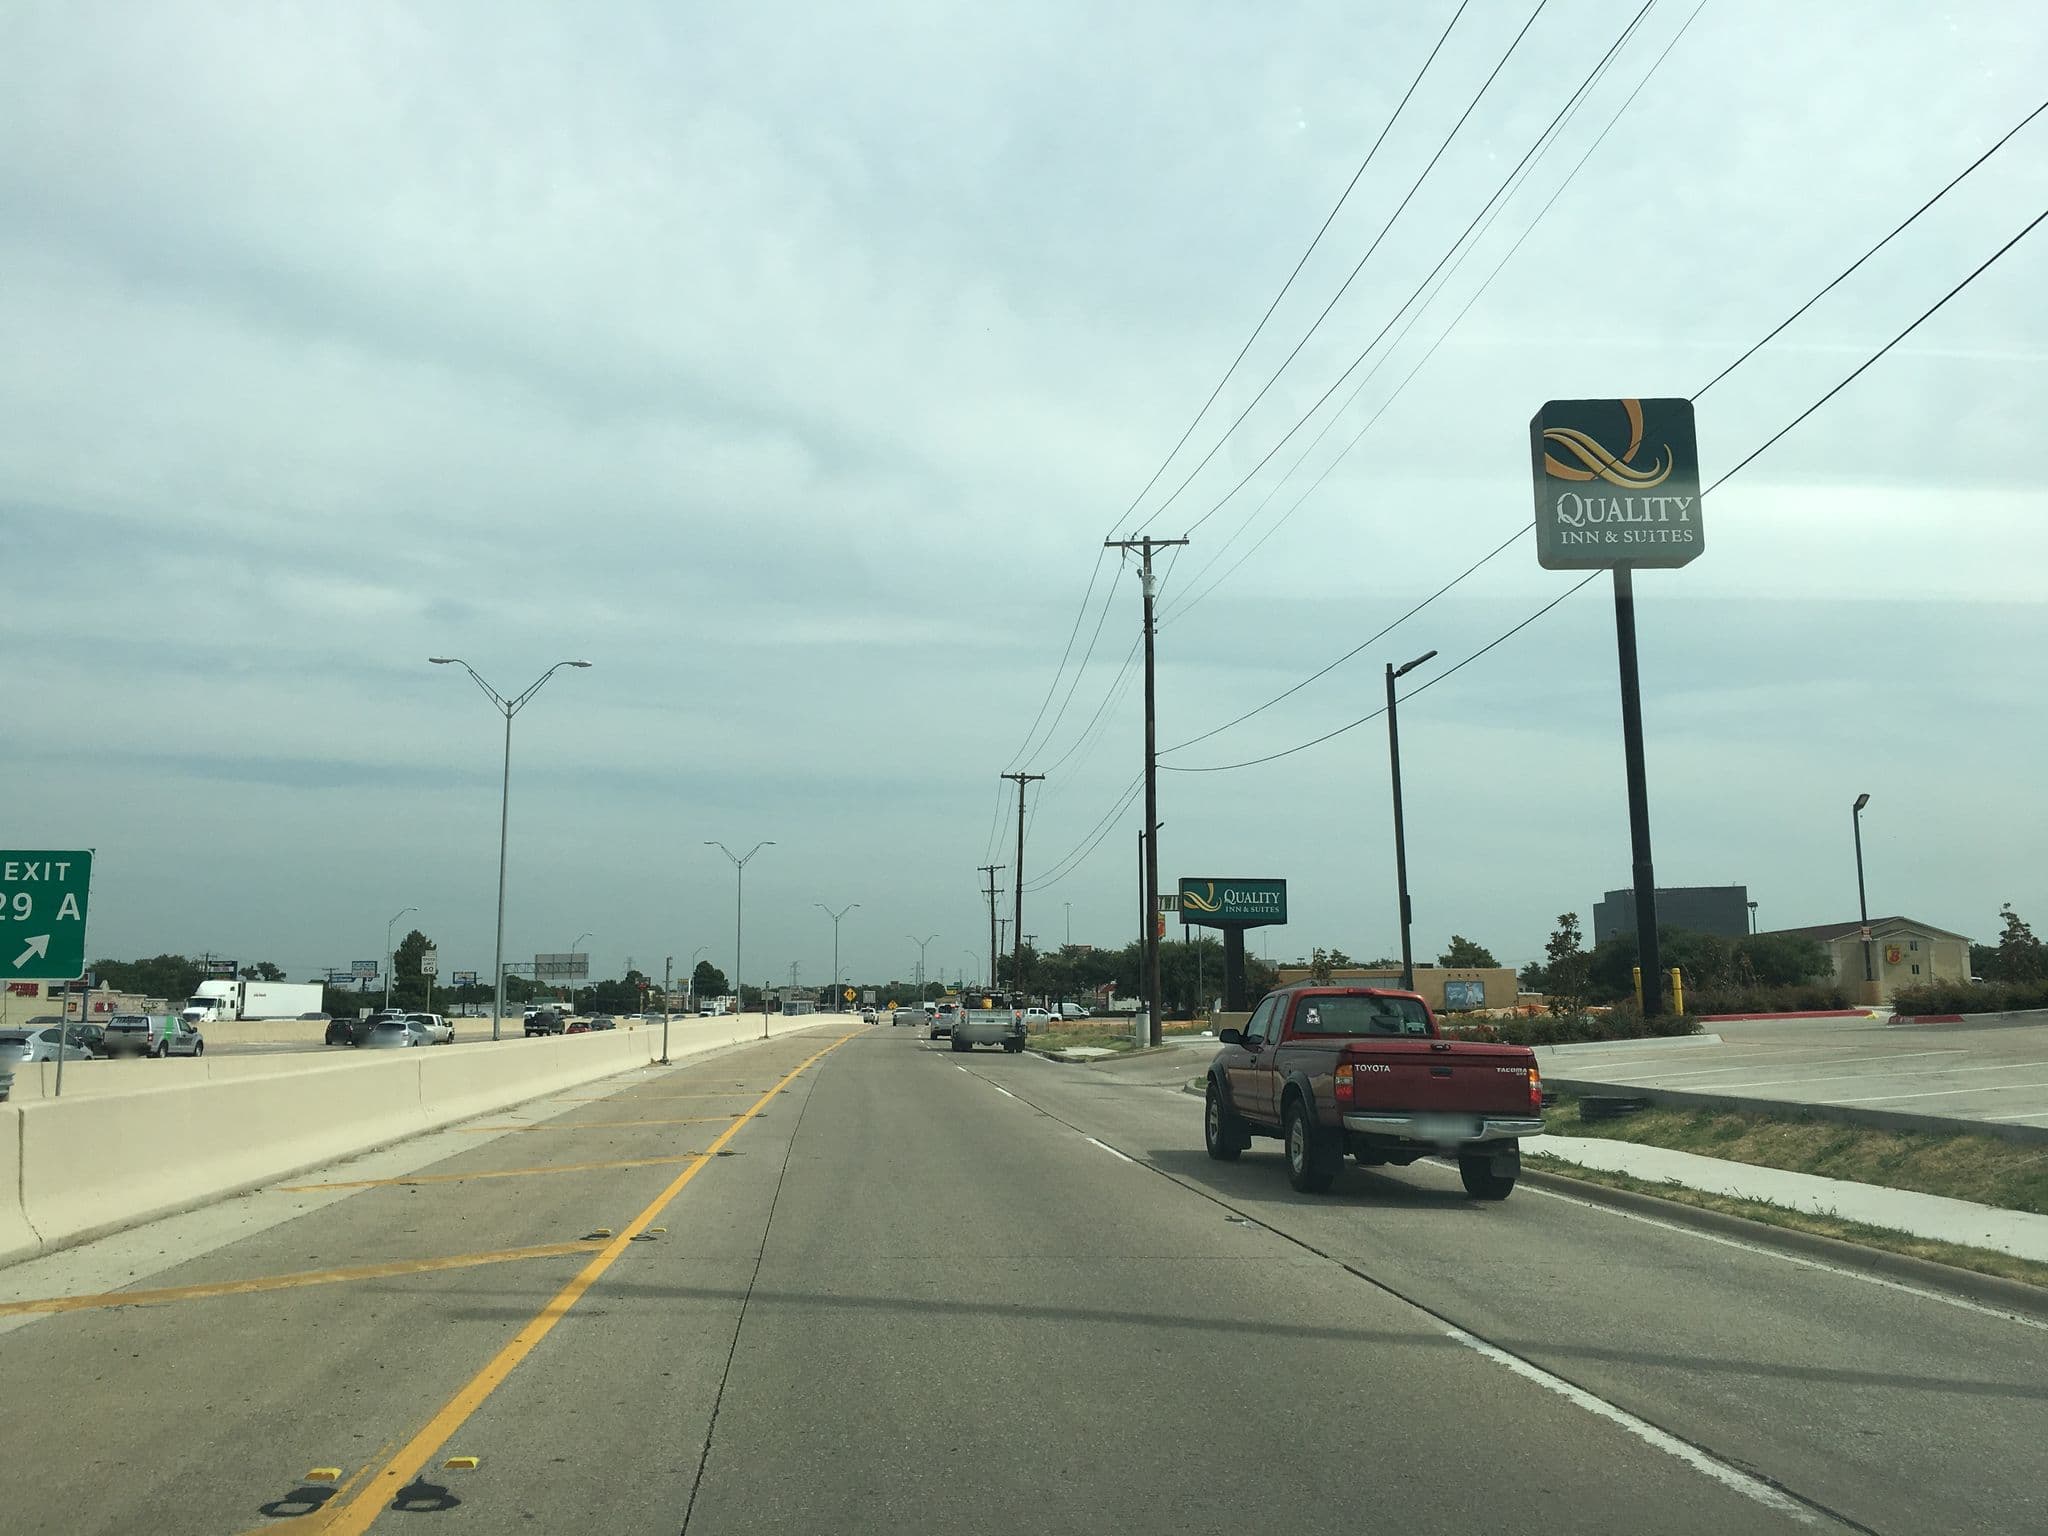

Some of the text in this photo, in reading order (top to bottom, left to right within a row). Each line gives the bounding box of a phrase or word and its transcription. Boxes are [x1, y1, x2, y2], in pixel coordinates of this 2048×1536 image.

[1557, 492, 1694, 527] QUALITY
[1561, 529, 1693, 544] INN & SUITES
[4, 861, 71, 881] EXIT
[1224, 889, 1280, 905] QUALITY
[55, 892, 81, 921] A
[1354, 1064, 1391, 1073] TOYOTA
